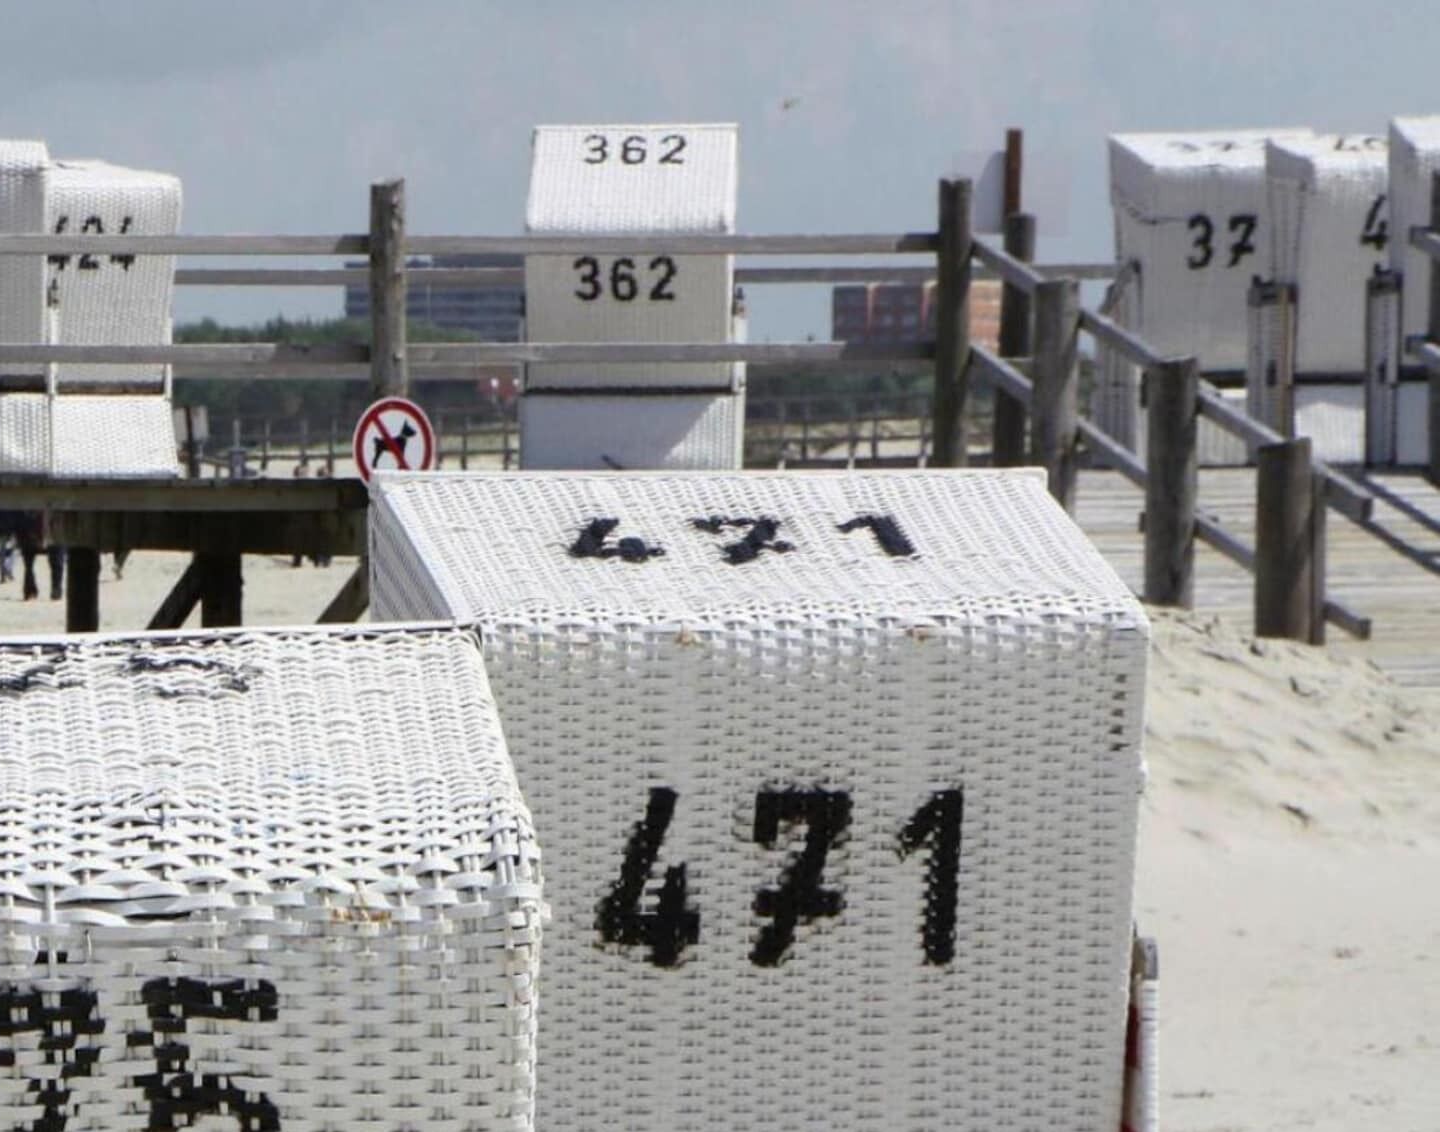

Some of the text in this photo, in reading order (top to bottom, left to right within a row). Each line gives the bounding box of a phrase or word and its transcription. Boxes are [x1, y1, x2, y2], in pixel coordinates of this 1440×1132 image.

[583, 133, 688, 165] 362
[573, 255, 678, 302] 362
[565, 513, 918, 566] 471
[594, 786, 965, 969] 471
